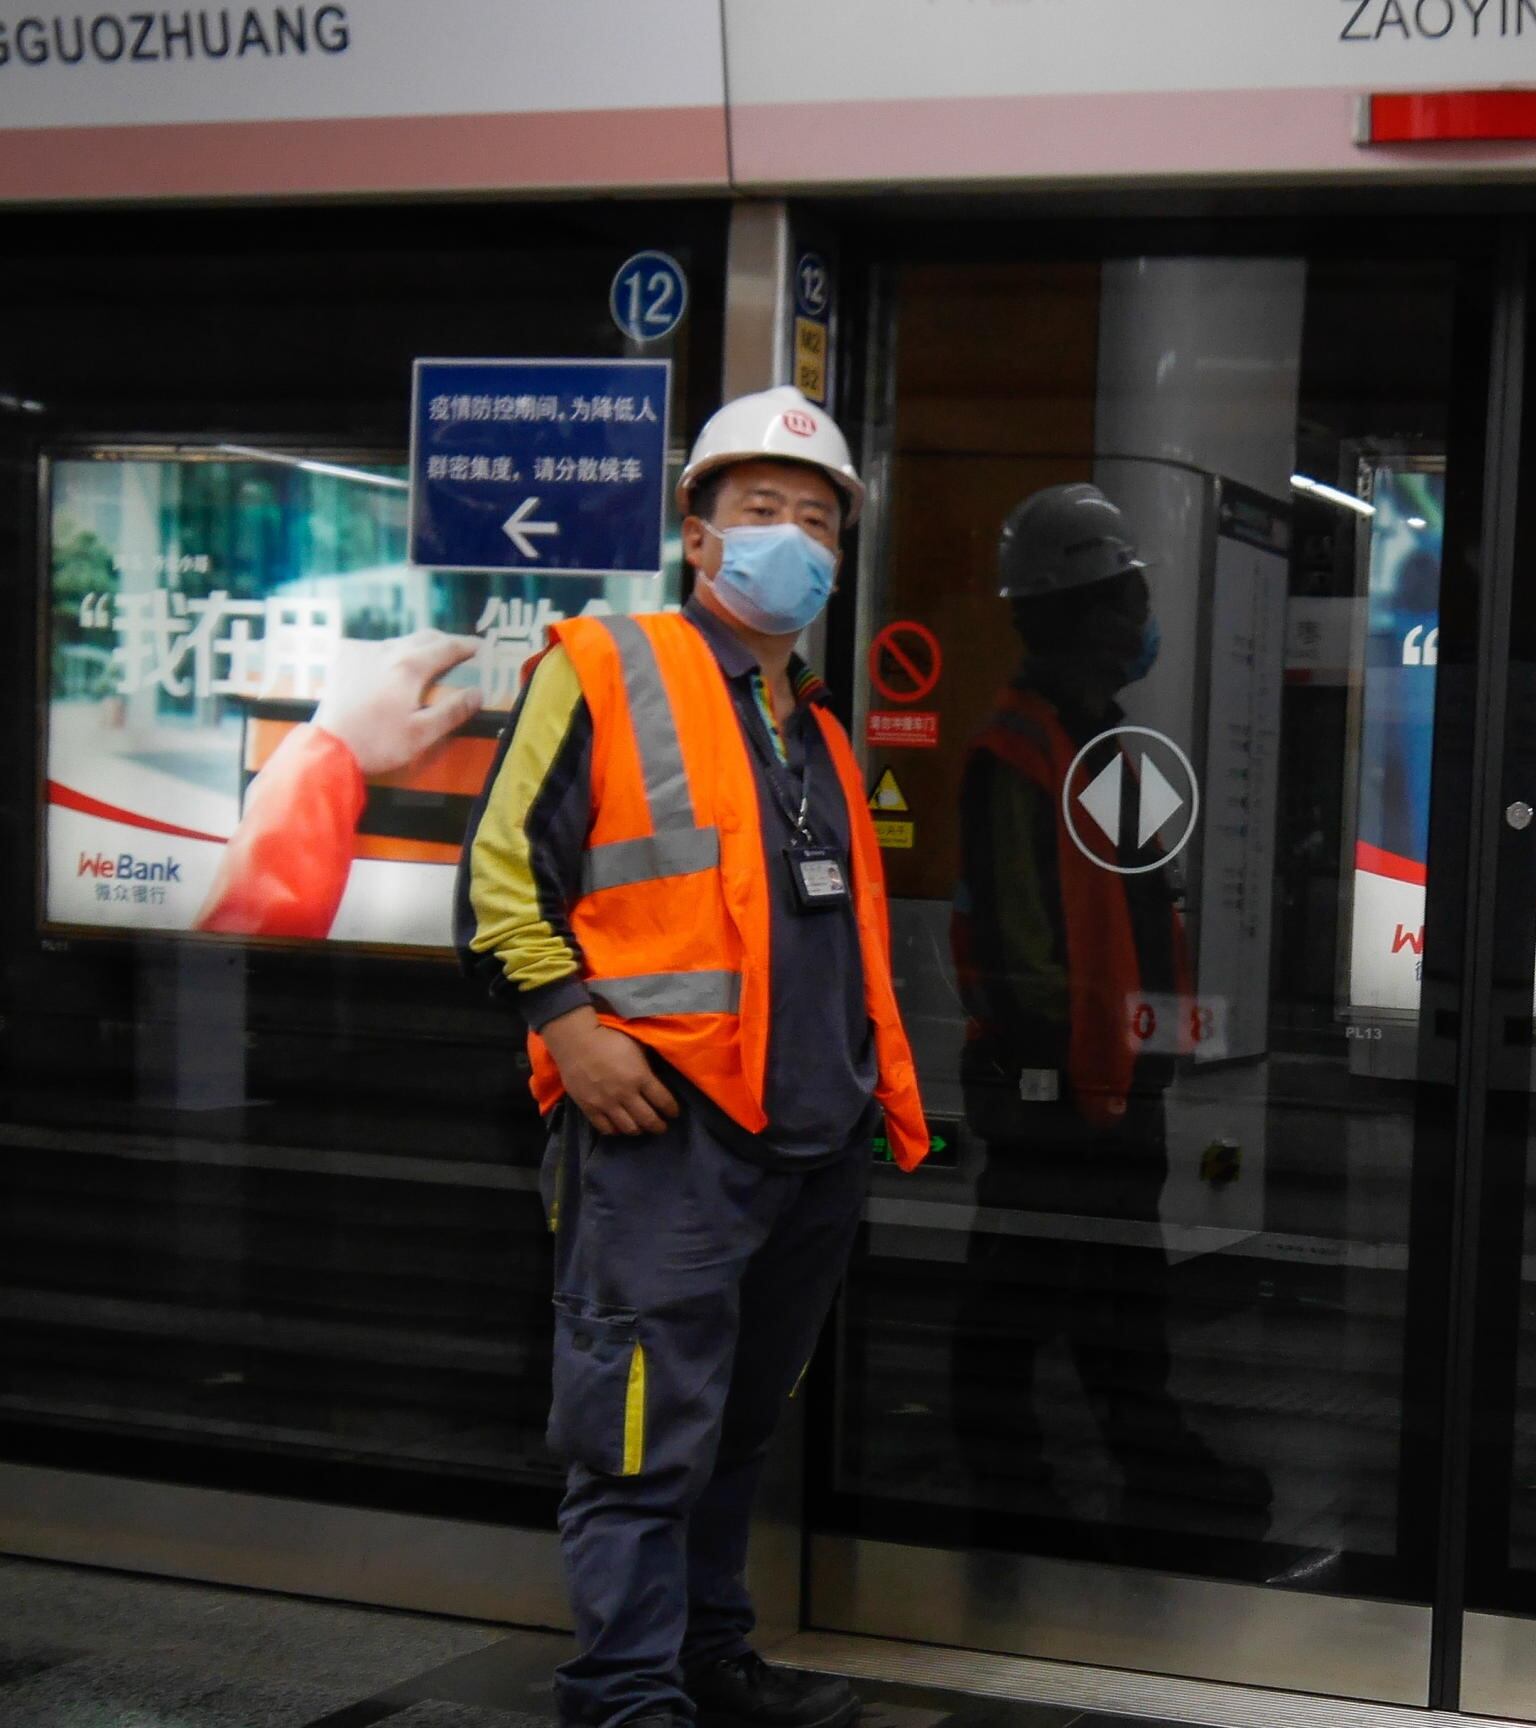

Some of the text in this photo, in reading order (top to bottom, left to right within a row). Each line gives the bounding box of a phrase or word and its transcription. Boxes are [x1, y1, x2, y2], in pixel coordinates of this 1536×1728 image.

[0, 6, 350, 66] GUOZHUANG
[624, 271, 675, 324] 12
[801, 264, 825, 304] 12
[77, 852, 182, 882] WeBank
[1345, 1026, 1382, 1040] PL13
